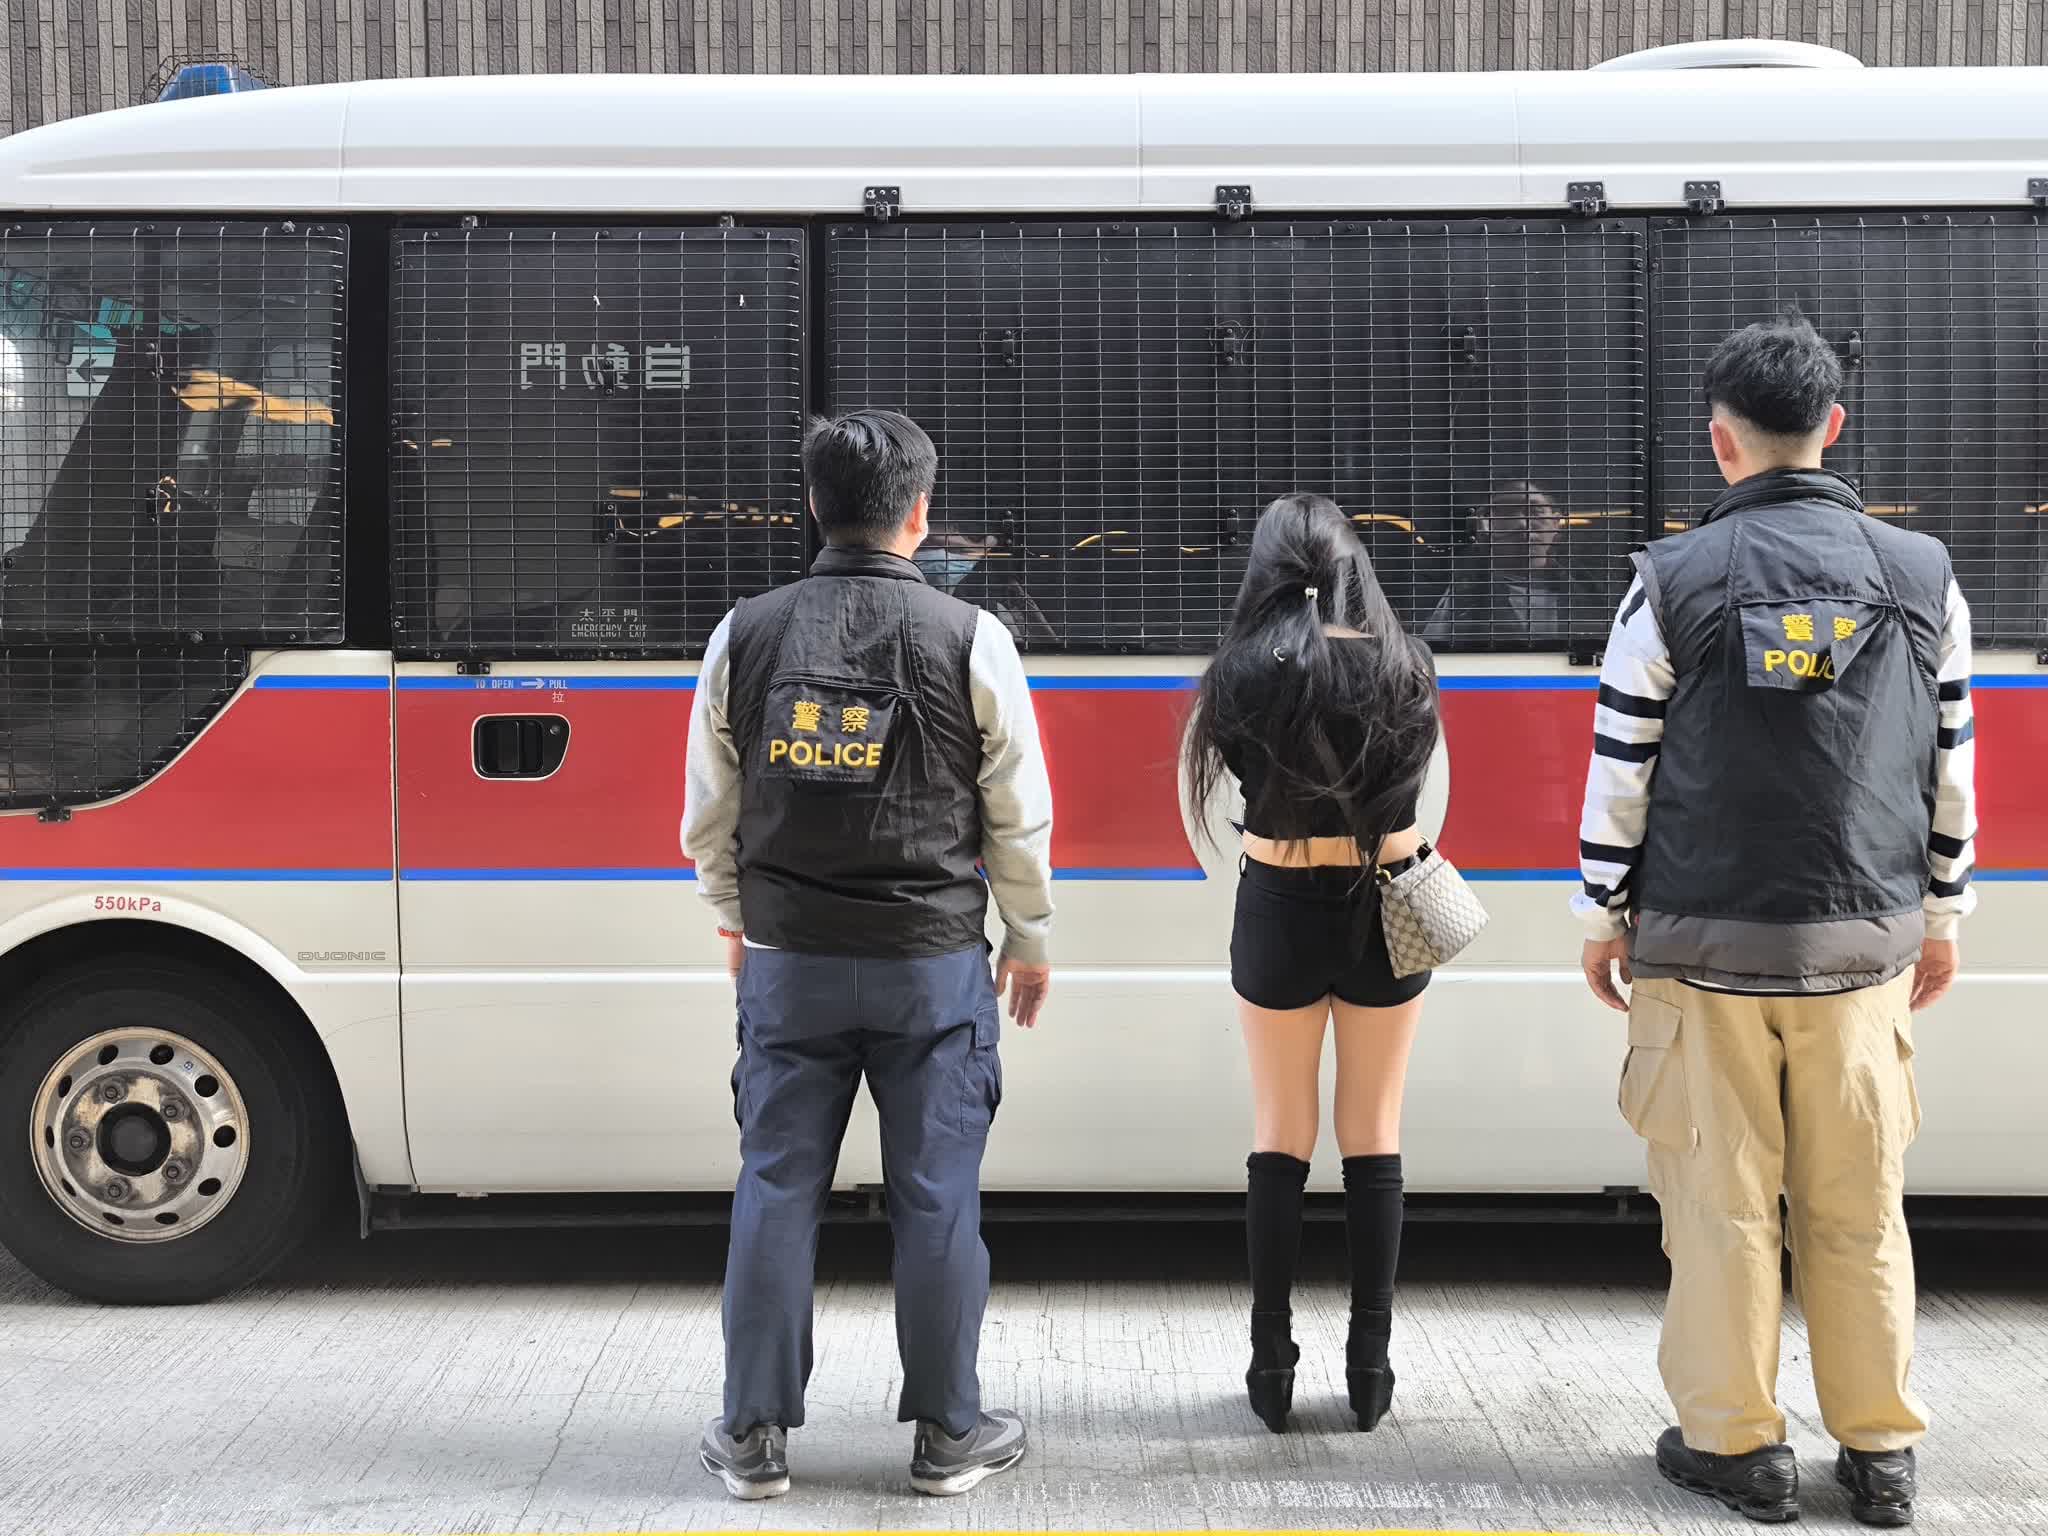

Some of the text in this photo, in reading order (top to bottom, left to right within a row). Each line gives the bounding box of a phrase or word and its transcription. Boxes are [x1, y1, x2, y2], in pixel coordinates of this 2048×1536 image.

[579, 607, 638, 623] 太平門
[571, 623, 647, 638] EMERGENCY EXIT
[475, 679, 568, 690] TO OPEN PULL
[552, 691, 565, 704] 拉
[792, 700, 870, 733] 警察
[769, 738, 884, 767] POLICE
[94, 895, 162, 912] 550kPa
[297, 951, 386, 961] DUONIC
